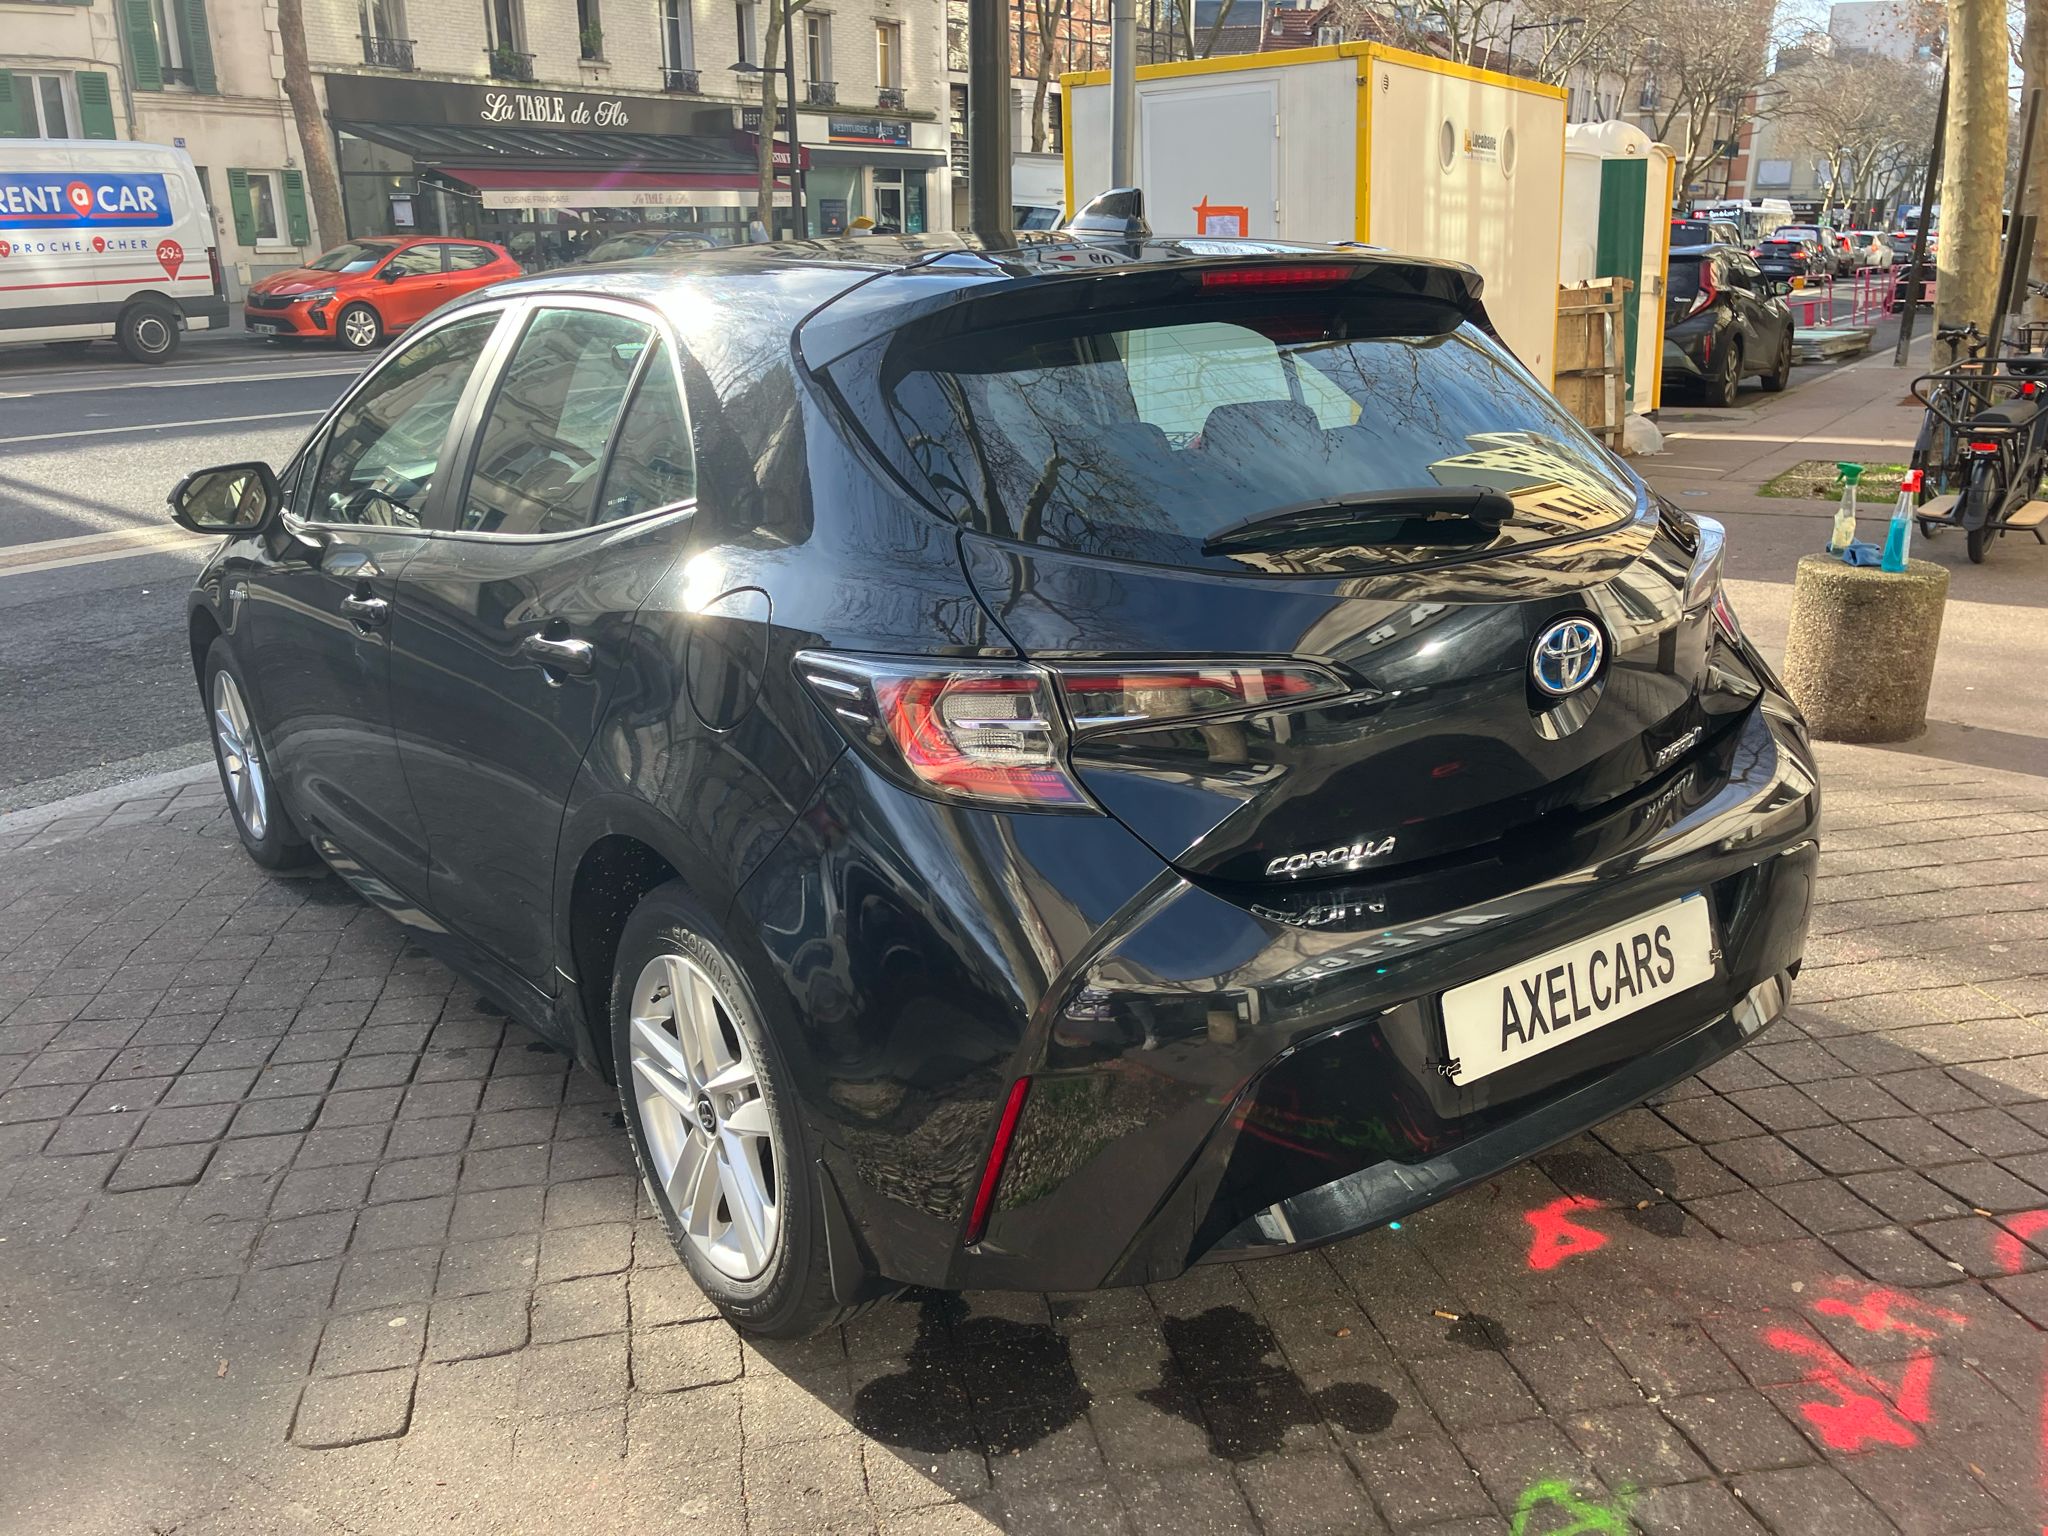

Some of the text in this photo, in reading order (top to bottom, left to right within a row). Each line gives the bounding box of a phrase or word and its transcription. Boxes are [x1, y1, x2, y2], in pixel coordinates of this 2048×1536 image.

[481, 93, 515, 122] La
[515, 94, 566, 123] TABLE
[570, 101, 591, 125] de
[71, 187, 89, 207] a
[96, 185, 157, 212] CAR
[106, 238, 149, 250] CHER
[1265, 836, 1396, 876] COROLLA
[1501, 924, 1675, 1052] AXELCARS
